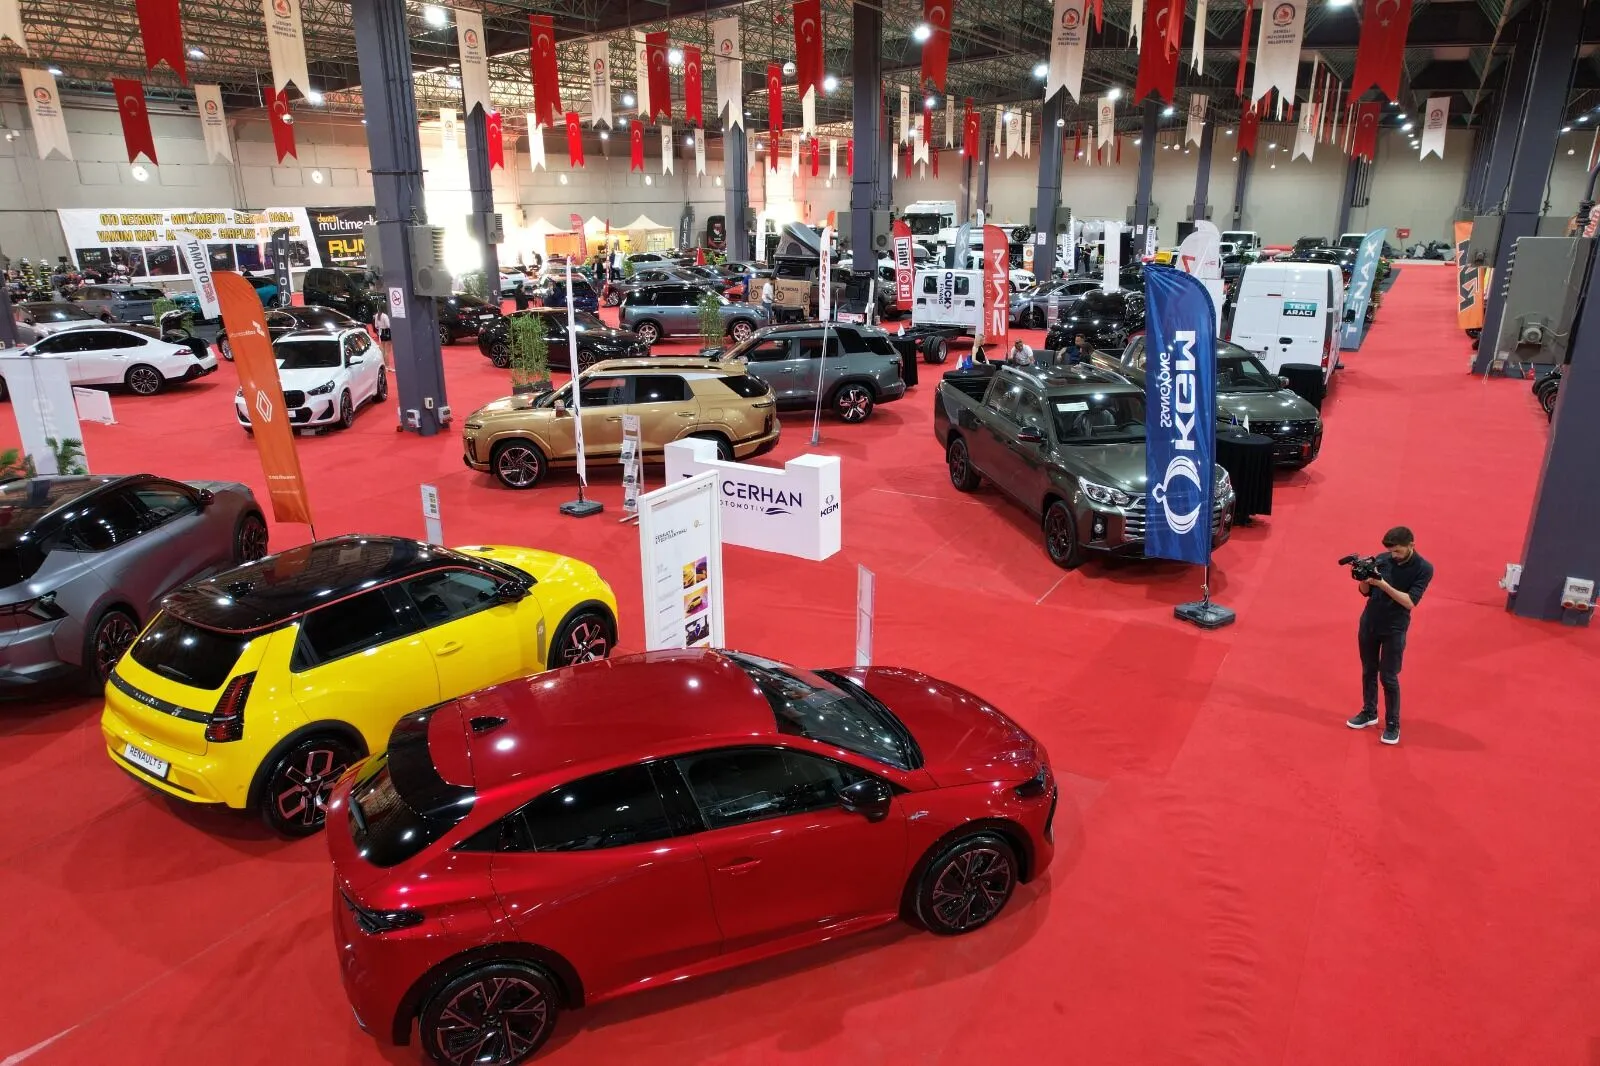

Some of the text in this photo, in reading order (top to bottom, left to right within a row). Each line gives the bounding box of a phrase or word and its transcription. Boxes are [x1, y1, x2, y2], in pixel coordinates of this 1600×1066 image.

[278, 233, 288, 286] OPEL
[944, 271, 954, 305] QUICK
[820, 502, 839, 518] KGM
[129, 745, 162, 770] RENAULT 5
